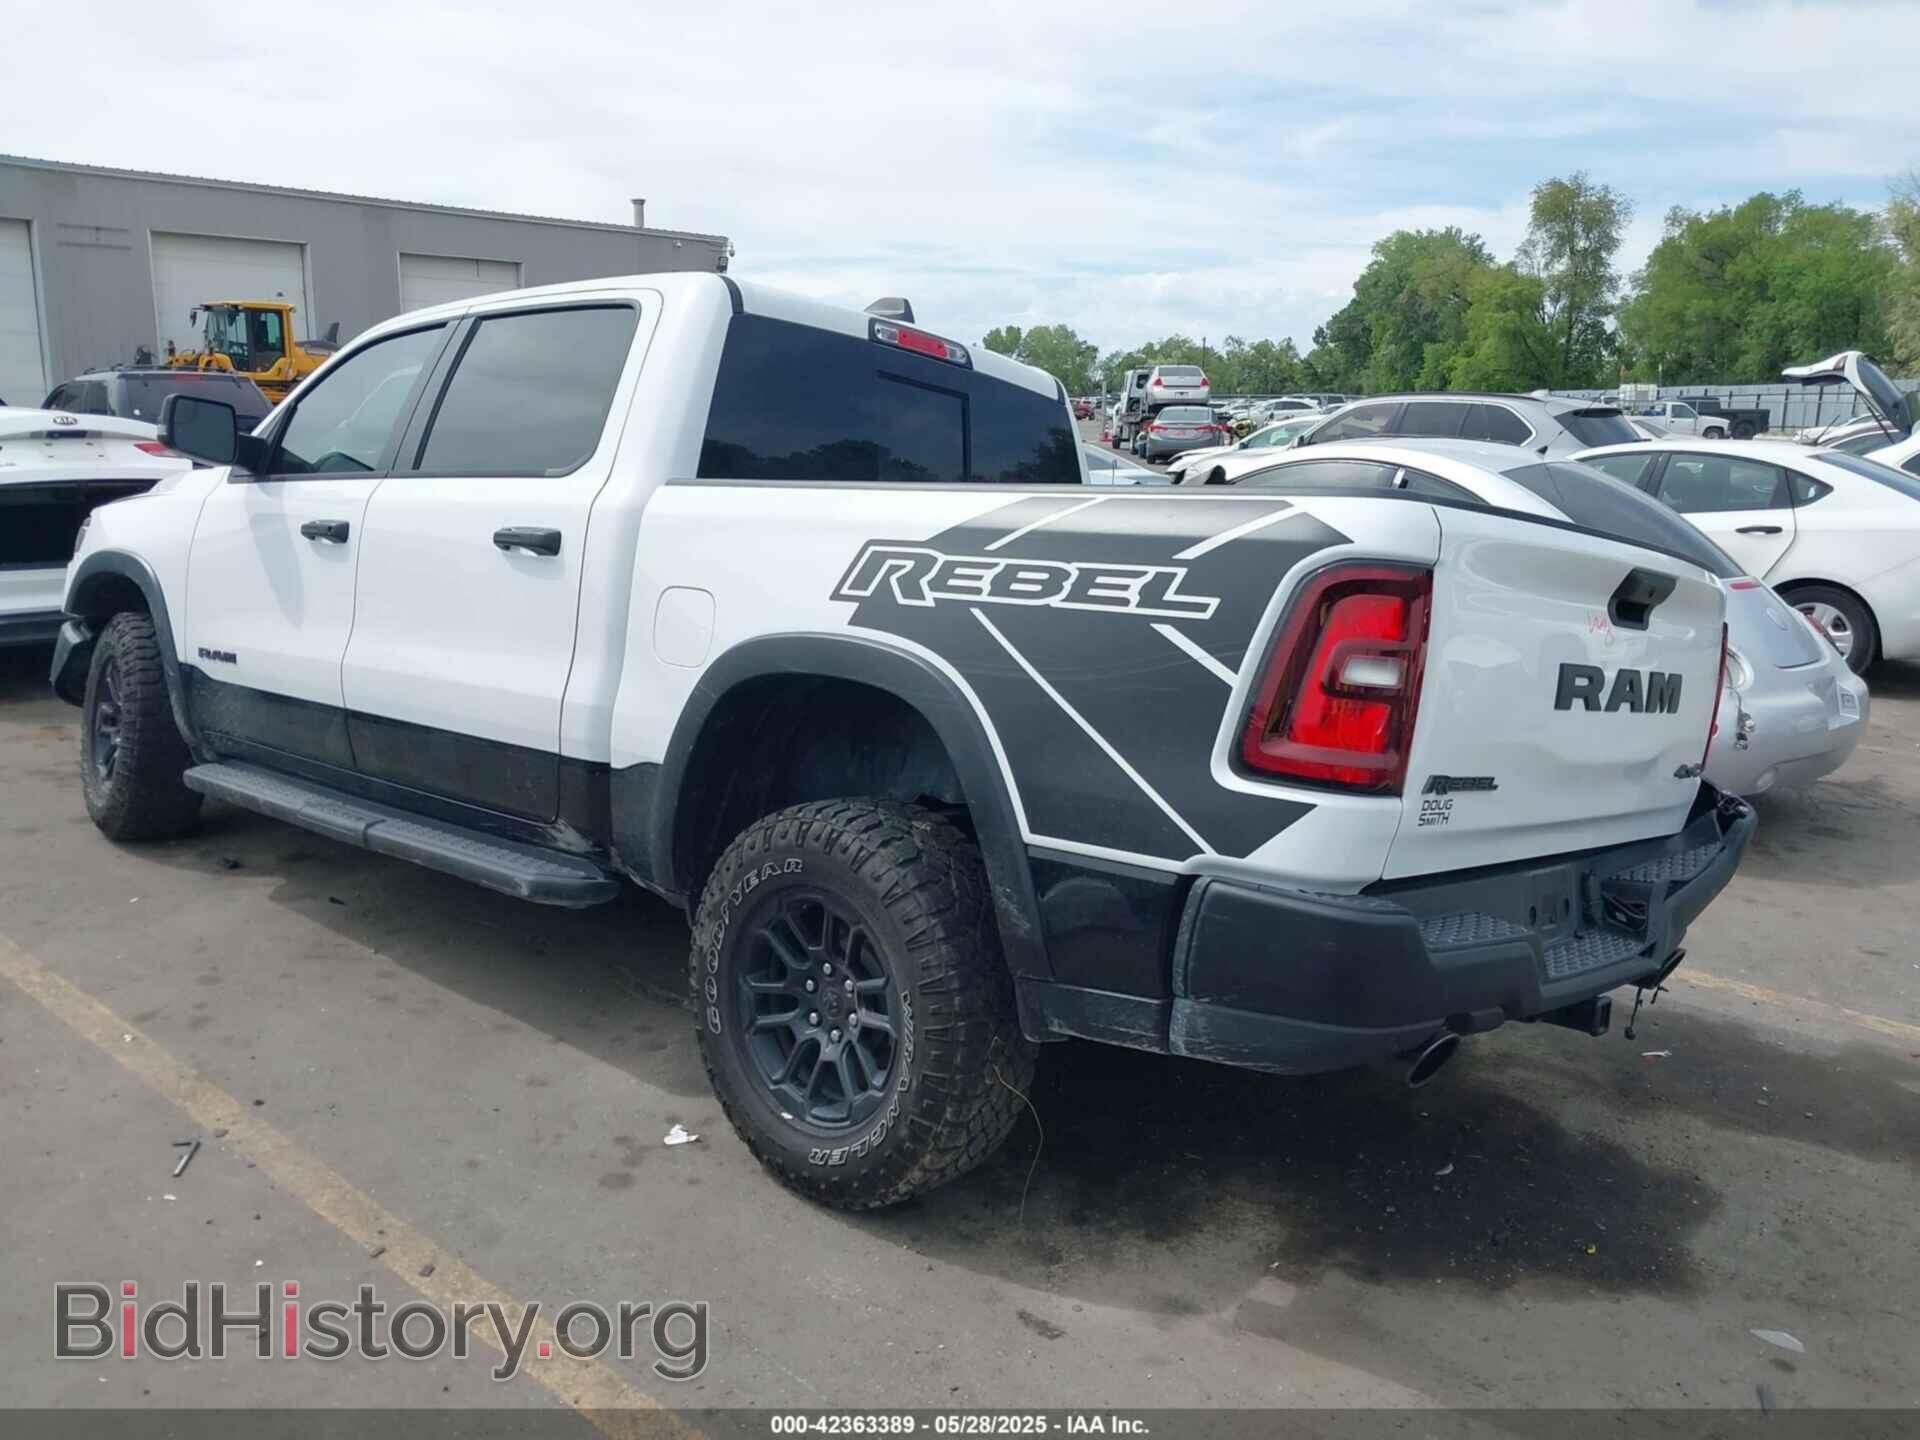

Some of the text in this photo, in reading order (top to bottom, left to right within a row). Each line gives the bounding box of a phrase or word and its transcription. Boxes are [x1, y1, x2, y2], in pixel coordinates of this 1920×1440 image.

[839, 545, 1222, 620] REBEL
[1554, 663, 1683, 714] RAM
[1421, 799, 1454, 811] DOUG
[808, 990, 917, 1167] WRANGLER
